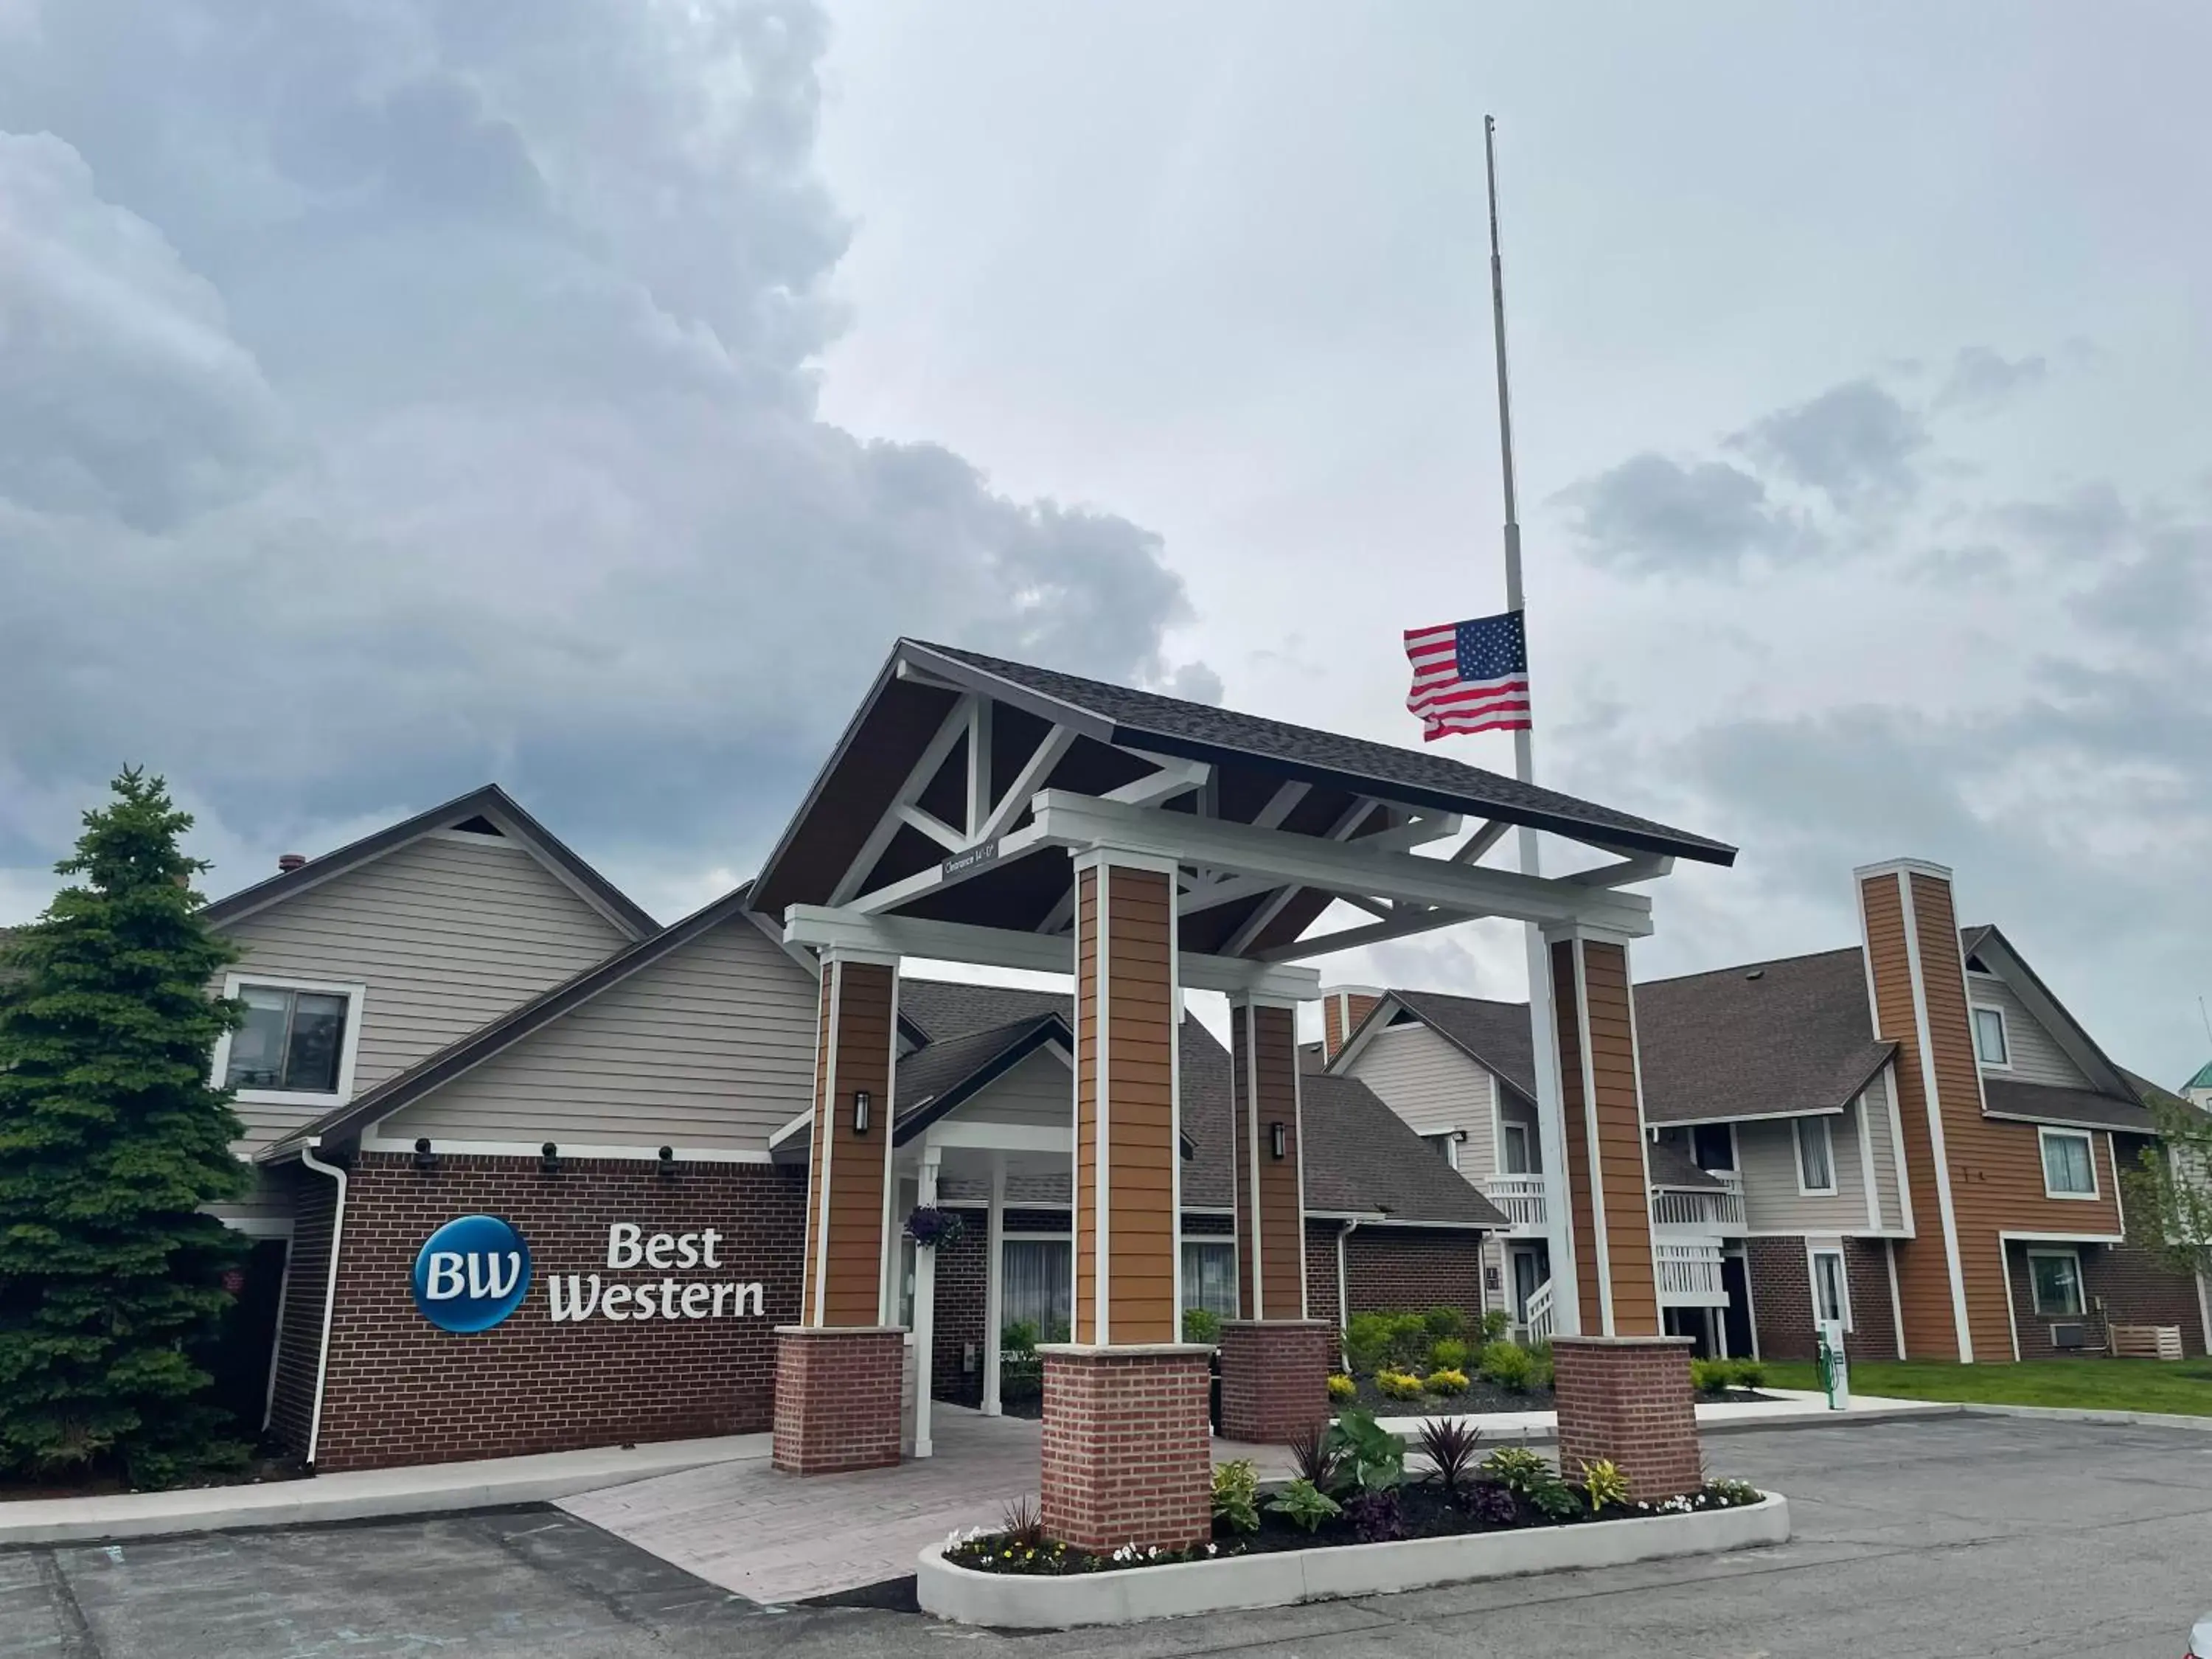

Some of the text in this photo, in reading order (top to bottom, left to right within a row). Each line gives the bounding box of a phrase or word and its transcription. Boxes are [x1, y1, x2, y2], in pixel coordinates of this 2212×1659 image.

[607, 1222, 723, 1270] Best
[425, 1251, 522, 1300] BW
[547, 1273, 765, 1323] Western
